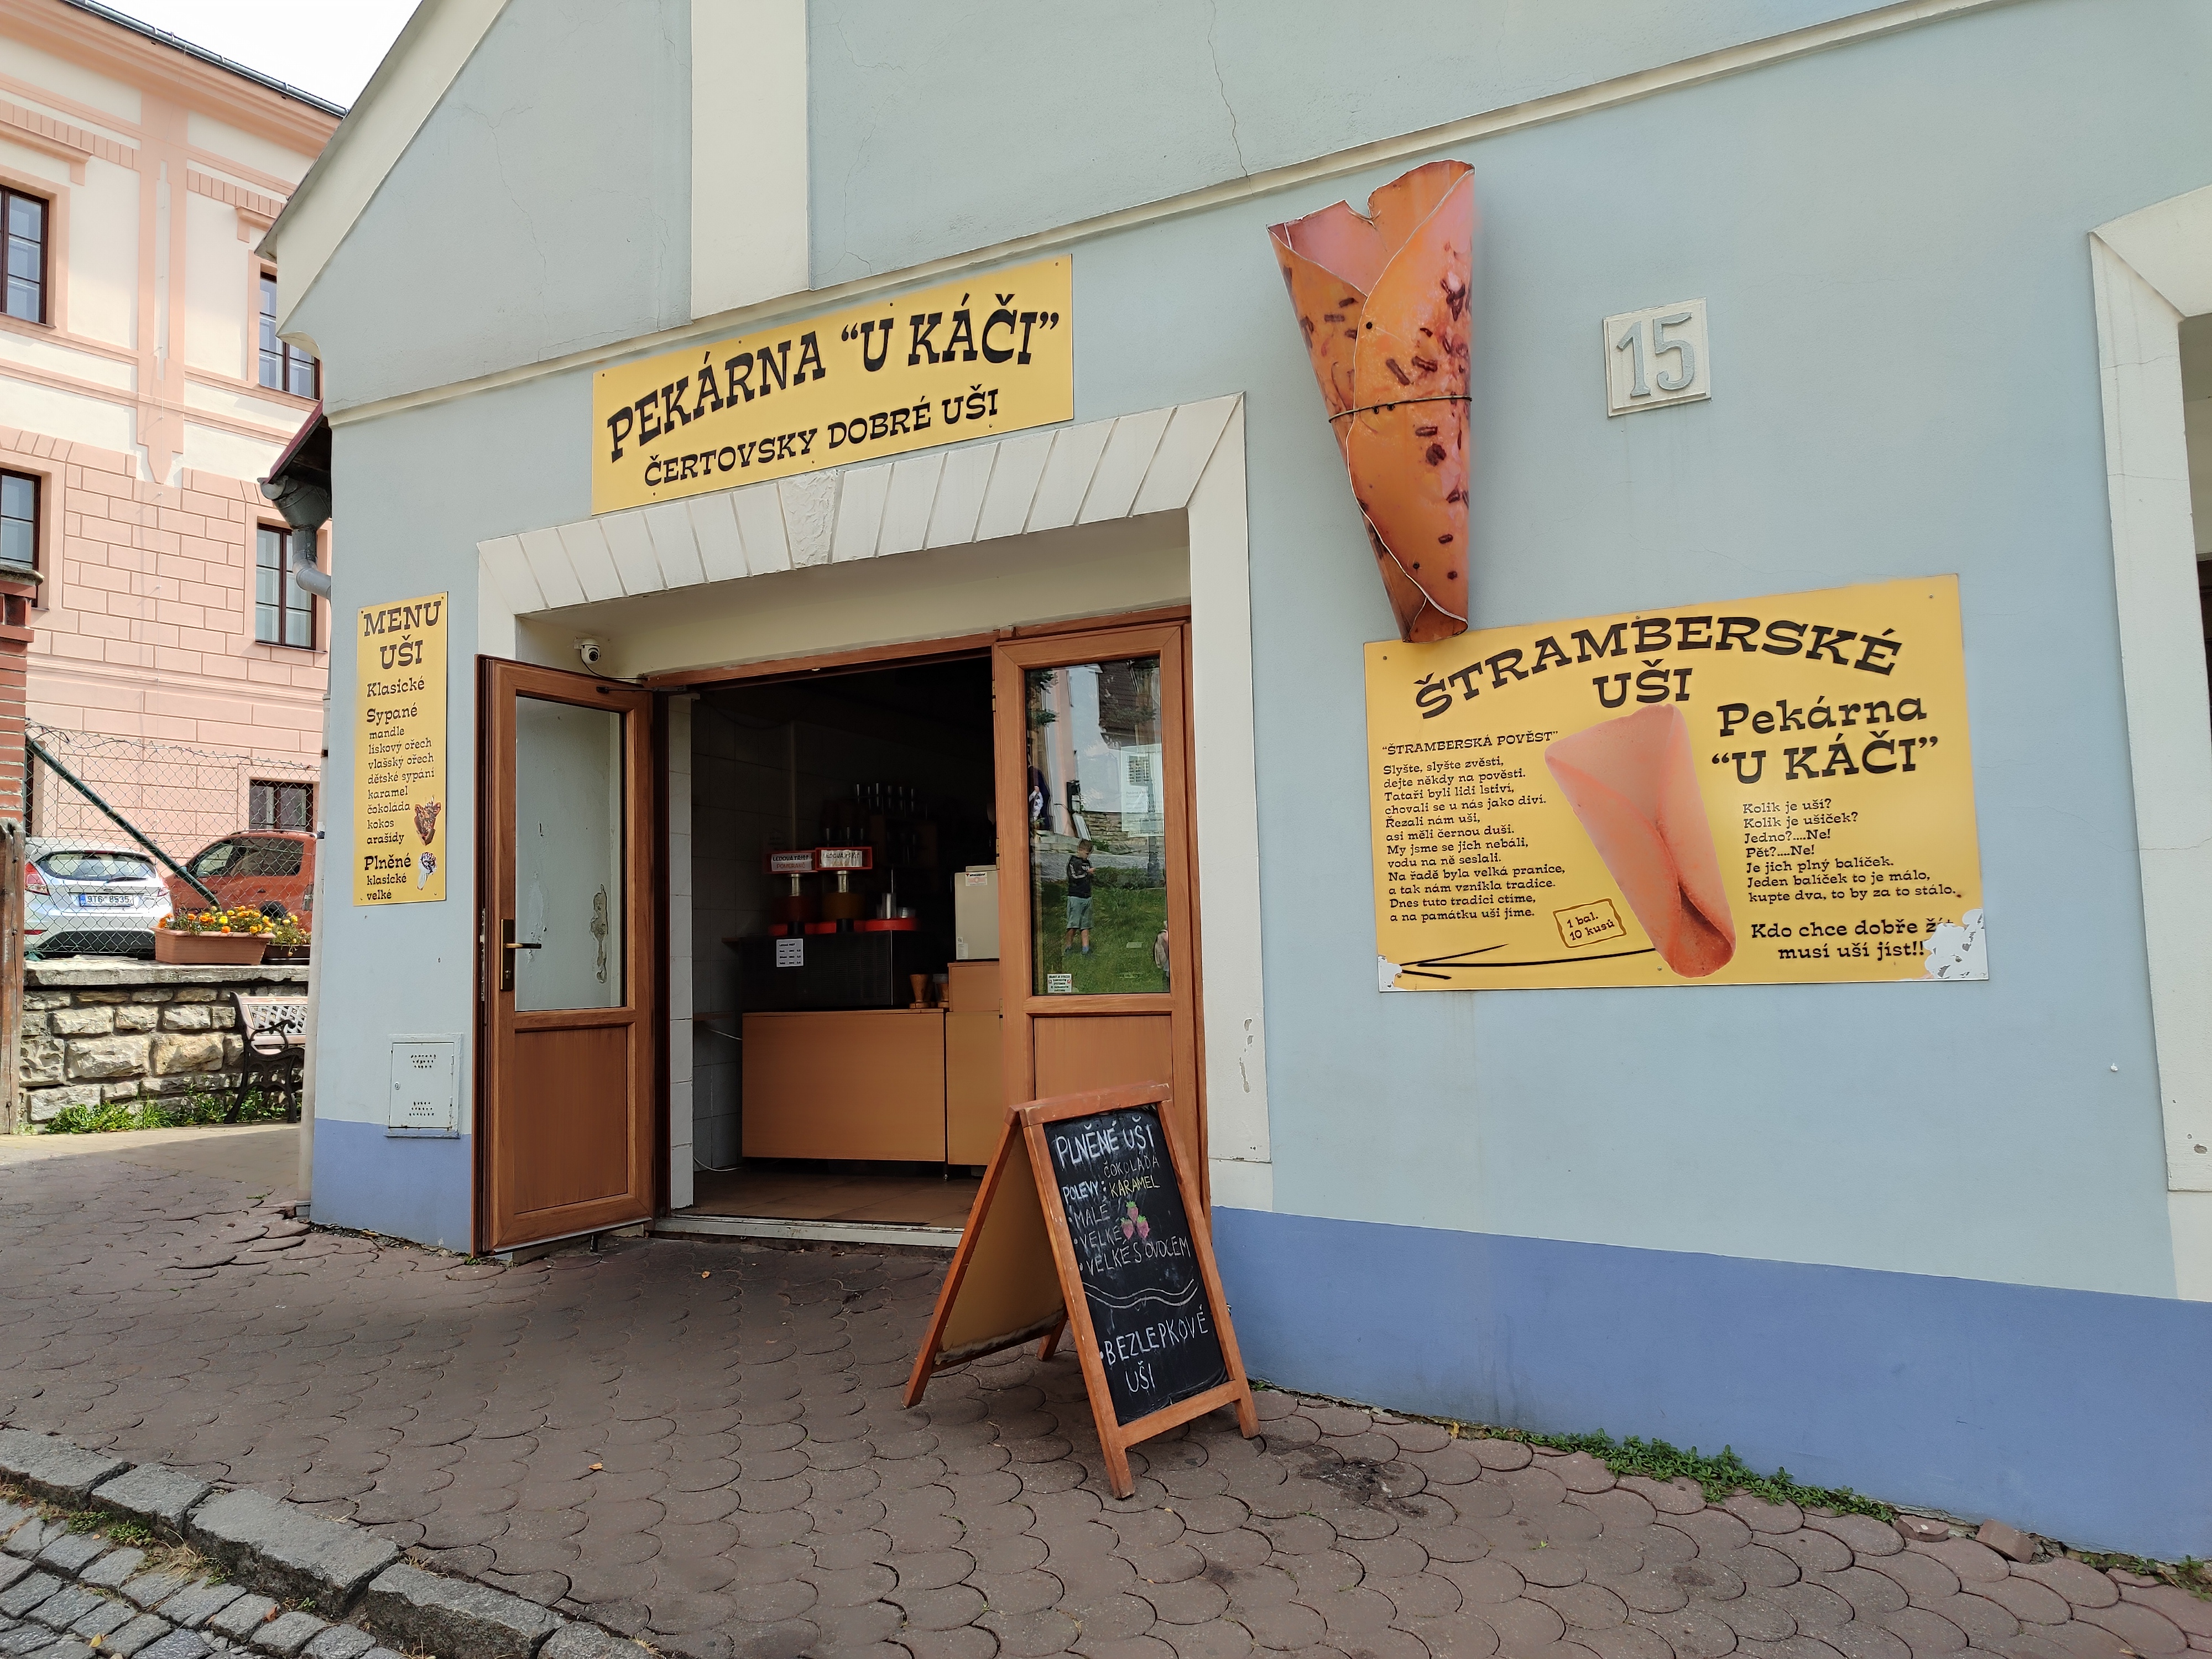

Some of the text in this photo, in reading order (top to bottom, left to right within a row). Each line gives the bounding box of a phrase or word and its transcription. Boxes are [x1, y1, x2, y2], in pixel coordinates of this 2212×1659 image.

[1616, 311, 1695, 397] 15
[607, 331, 826, 463] PEKÁRNA
[907, 293, 1060, 366] KÁČI”
[644, 384, 999, 487] ČERTOVSKY DOBRÉ UŠI
[363, 601, 442, 637] MENU
[379, 634, 423, 670] UŠI
[1413, 615, 1902, 719] ŠTRAMBERSKÉ
[367, 675, 425, 698] Klasické
[1592, 659, 1693, 708] UŠI
[366, 702, 418, 726] Sypané
[1717, 696, 1927, 737] Pekárna
[369, 726, 405, 739] mandle
[368, 737, 432, 754] lískový ořech
[1382, 730, 1558, 755] “ŠTRAMBERSKÁ POVĚST”
[368, 752, 434, 770] vlašský ořech
[1783, 730, 1939, 781] KÁČI”
[1383, 755, 1504, 776] Slyšte, slyšte zvěsti,
[368, 766, 435, 785] dětské sypání
[1384, 778, 1413, 790] dejte
[1417, 774, 1454, 786] někdy
[1478, 768, 1526, 784] pověsti.
[368, 785, 408, 800] karamel
[1384, 782, 1514, 801] Tataři byli lidi lstiví,
[367, 800, 411, 815] čokoláda
[1385, 802, 1429, 815] chovali
[1461, 799, 1483, 809] nás
[1487, 797, 1514, 811] jako
[1518, 794, 1546, 805] diví.
[1743, 798, 1832, 815] Kolik je uší?
[367, 818, 394, 830] kokos
[1385, 812, 1480, 828] Řezali nám uši,
[1744, 811, 1858, 830] Kolik je ušiček?
[367, 831, 405, 845] arašídy
[1386, 824, 1514, 842] asi měli černou duši.
[1386, 844, 1406, 857] My
[1410, 844, 1438, 856] jsme
[1458, 839, 1481, 853] jich
[1485, 837, 1528, 849] nebáli,
[364, 852, 411, 871] Plněné
[1387, 857, 1417, 868] vodu
[1440, 855, 1455, 865] ně
[1459, 852, 1501, 864] seslali.
[1746, 855, 1894, 875] Je jich plný balíček.
[367, 873, 407, 885] klasické
[1388, 863, 1566, 881] Na řadě byla velká pranice,
[1747, 869, 1931, 888] Jeden balíček to je málo,
[367, 888, 392, 901] velké
[1400, 884, 1421, 894] tak
[1424, 883, 1452, 893] nám
[1455, 880, 1503, 892] vznikla
[1506, 878, 1556, 889] tradice.
[1748, 892, 1791, 905] kupte
[1795, 889, 1827, 900] dva,
[1831, 890, 1845, 899] to
[1849, 888, 1868, 901] by
[1895, 887, 1910, 896] to
[1915, 884, 1956, 895] stálo.
[1389, 893, 1536, 908] Dnes tuto tradici ctíme,
[1421, 909, 1478, 924] památku
[1481, 907, 1500, 918] uši
[1504, 907, 1535, 920] jíme.
[1566, 911, 1599, 928] 1 bal.
[1569, 919, 1615, 941] 10 kusů
[1751, 922, 1792, 938] Kdo
[1799, 921, 1848, 937] chce
[1855, 919, 1918, 935] dobře
[1777, 943, 1830, 959] musí
[1837, 942, 1870, 957] uší
[1055, 1115, 1155, 1168] PLNĚNÉ UŠI
[1108, 1175, 1161, 1198] KARAMEL
[1086, 1235, 1191, 1276] VELKÉ S OVOCEM
[1104, 1304, 1208, 1366] BEZLEPKOVÉ
[1125, 1360, 1155, 1392] UŠI
